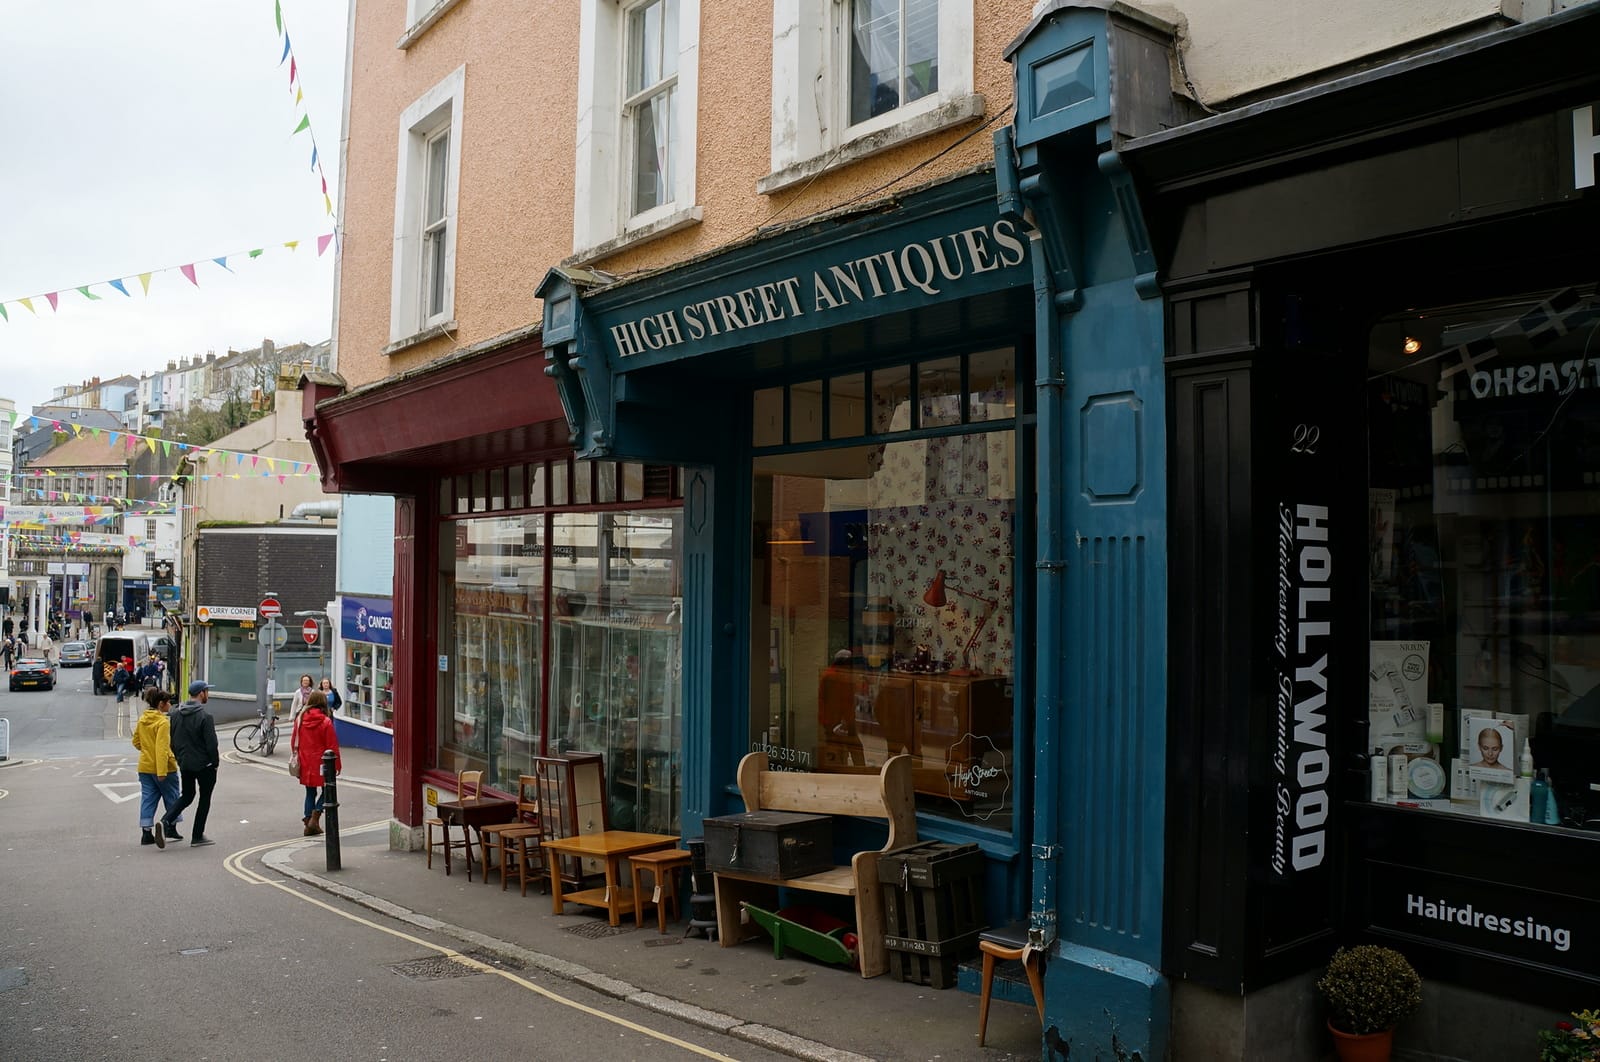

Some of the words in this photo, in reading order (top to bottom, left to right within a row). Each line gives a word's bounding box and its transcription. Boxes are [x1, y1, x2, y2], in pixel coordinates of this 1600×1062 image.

[609, 310, 684, 358] HIGH
[682, 276, 804, 341] STREET
[813, 220, 1025, 312] ANTIQUES
[1290, 423, 1320, 455] 22
[1275, 502, 1293, 658] Hairdressing
[368, 615, 392, 630] CANCER
[1274, 672, 1293, 775] Tanning
[1292, 503, 1331, 871] HOLLYWOOD
[780, 747, 795, 762] 313
[797, 751, 810, 765] 171
[952, 763, 972, 788] High
[1272, 782, 1290, 875] Beauty
[1407, 893, 1571, 951] Hairdressing
